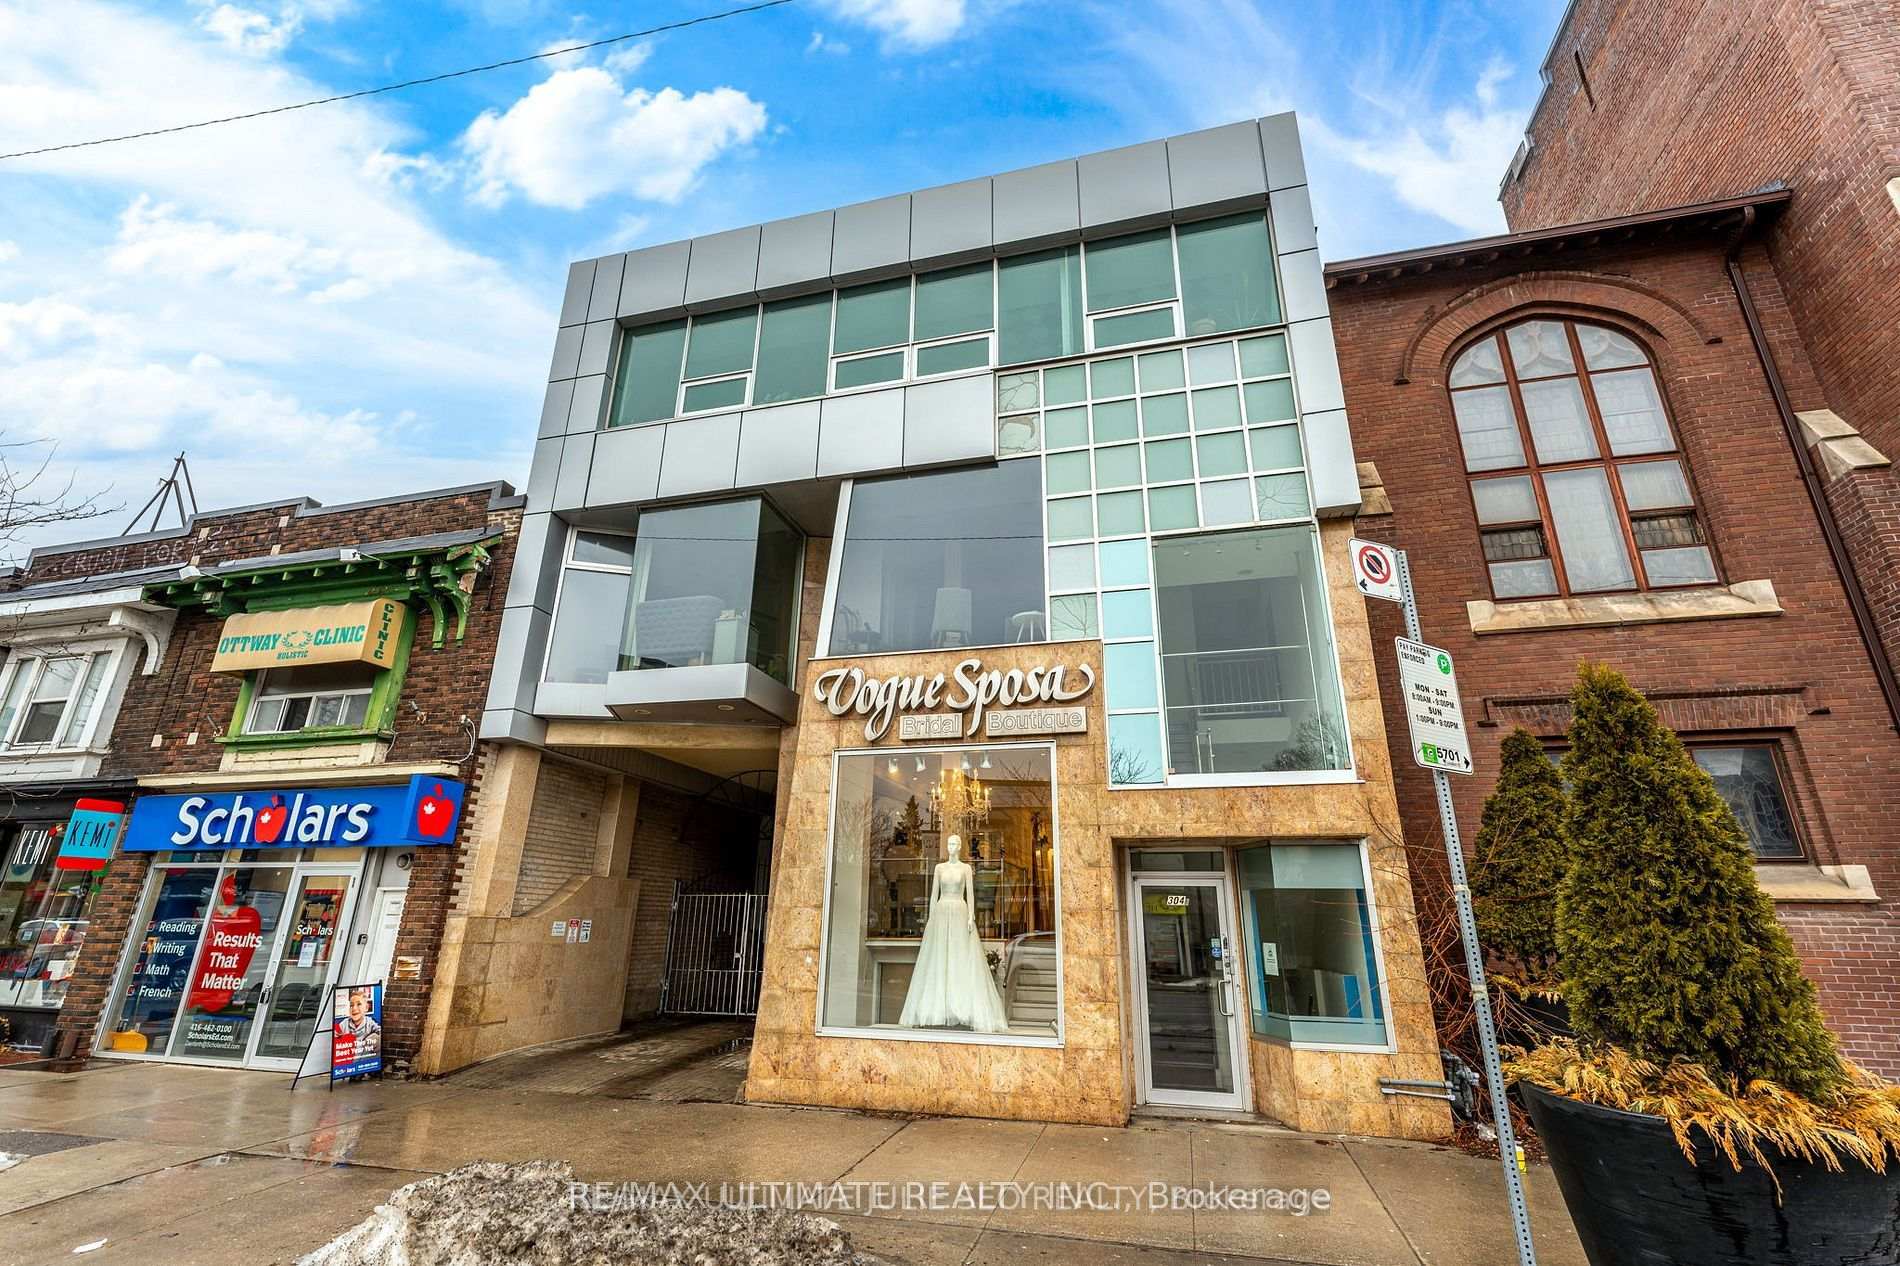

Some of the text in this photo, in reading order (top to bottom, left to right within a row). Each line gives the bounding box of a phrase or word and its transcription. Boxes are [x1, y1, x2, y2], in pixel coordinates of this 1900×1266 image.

[219, 624, 366, 654] OTTWAY CLINIC
[373, 603, 395, 660] CLINIC
[1415, 683, 1430, 694] MON
[1435, 688, 1448, 698] SAT
[814, 658, 1095, 741] Vogue Sposa
[1428, 706, 1442, 716] SUN
[902, 710, 1083, 737] Bridal Boutique
[1436, 746, 1460, 762] 5701
[159, 921, 198, 935] Reading
[212, 931, 263, 948] Results
[153, 942, 187, 956] Writing
[209, 951, 239, 969] That
[145, 963, 170, 976] Math
[201, 972, 247, 991] Matter
[139, 985, 172, 998] French
